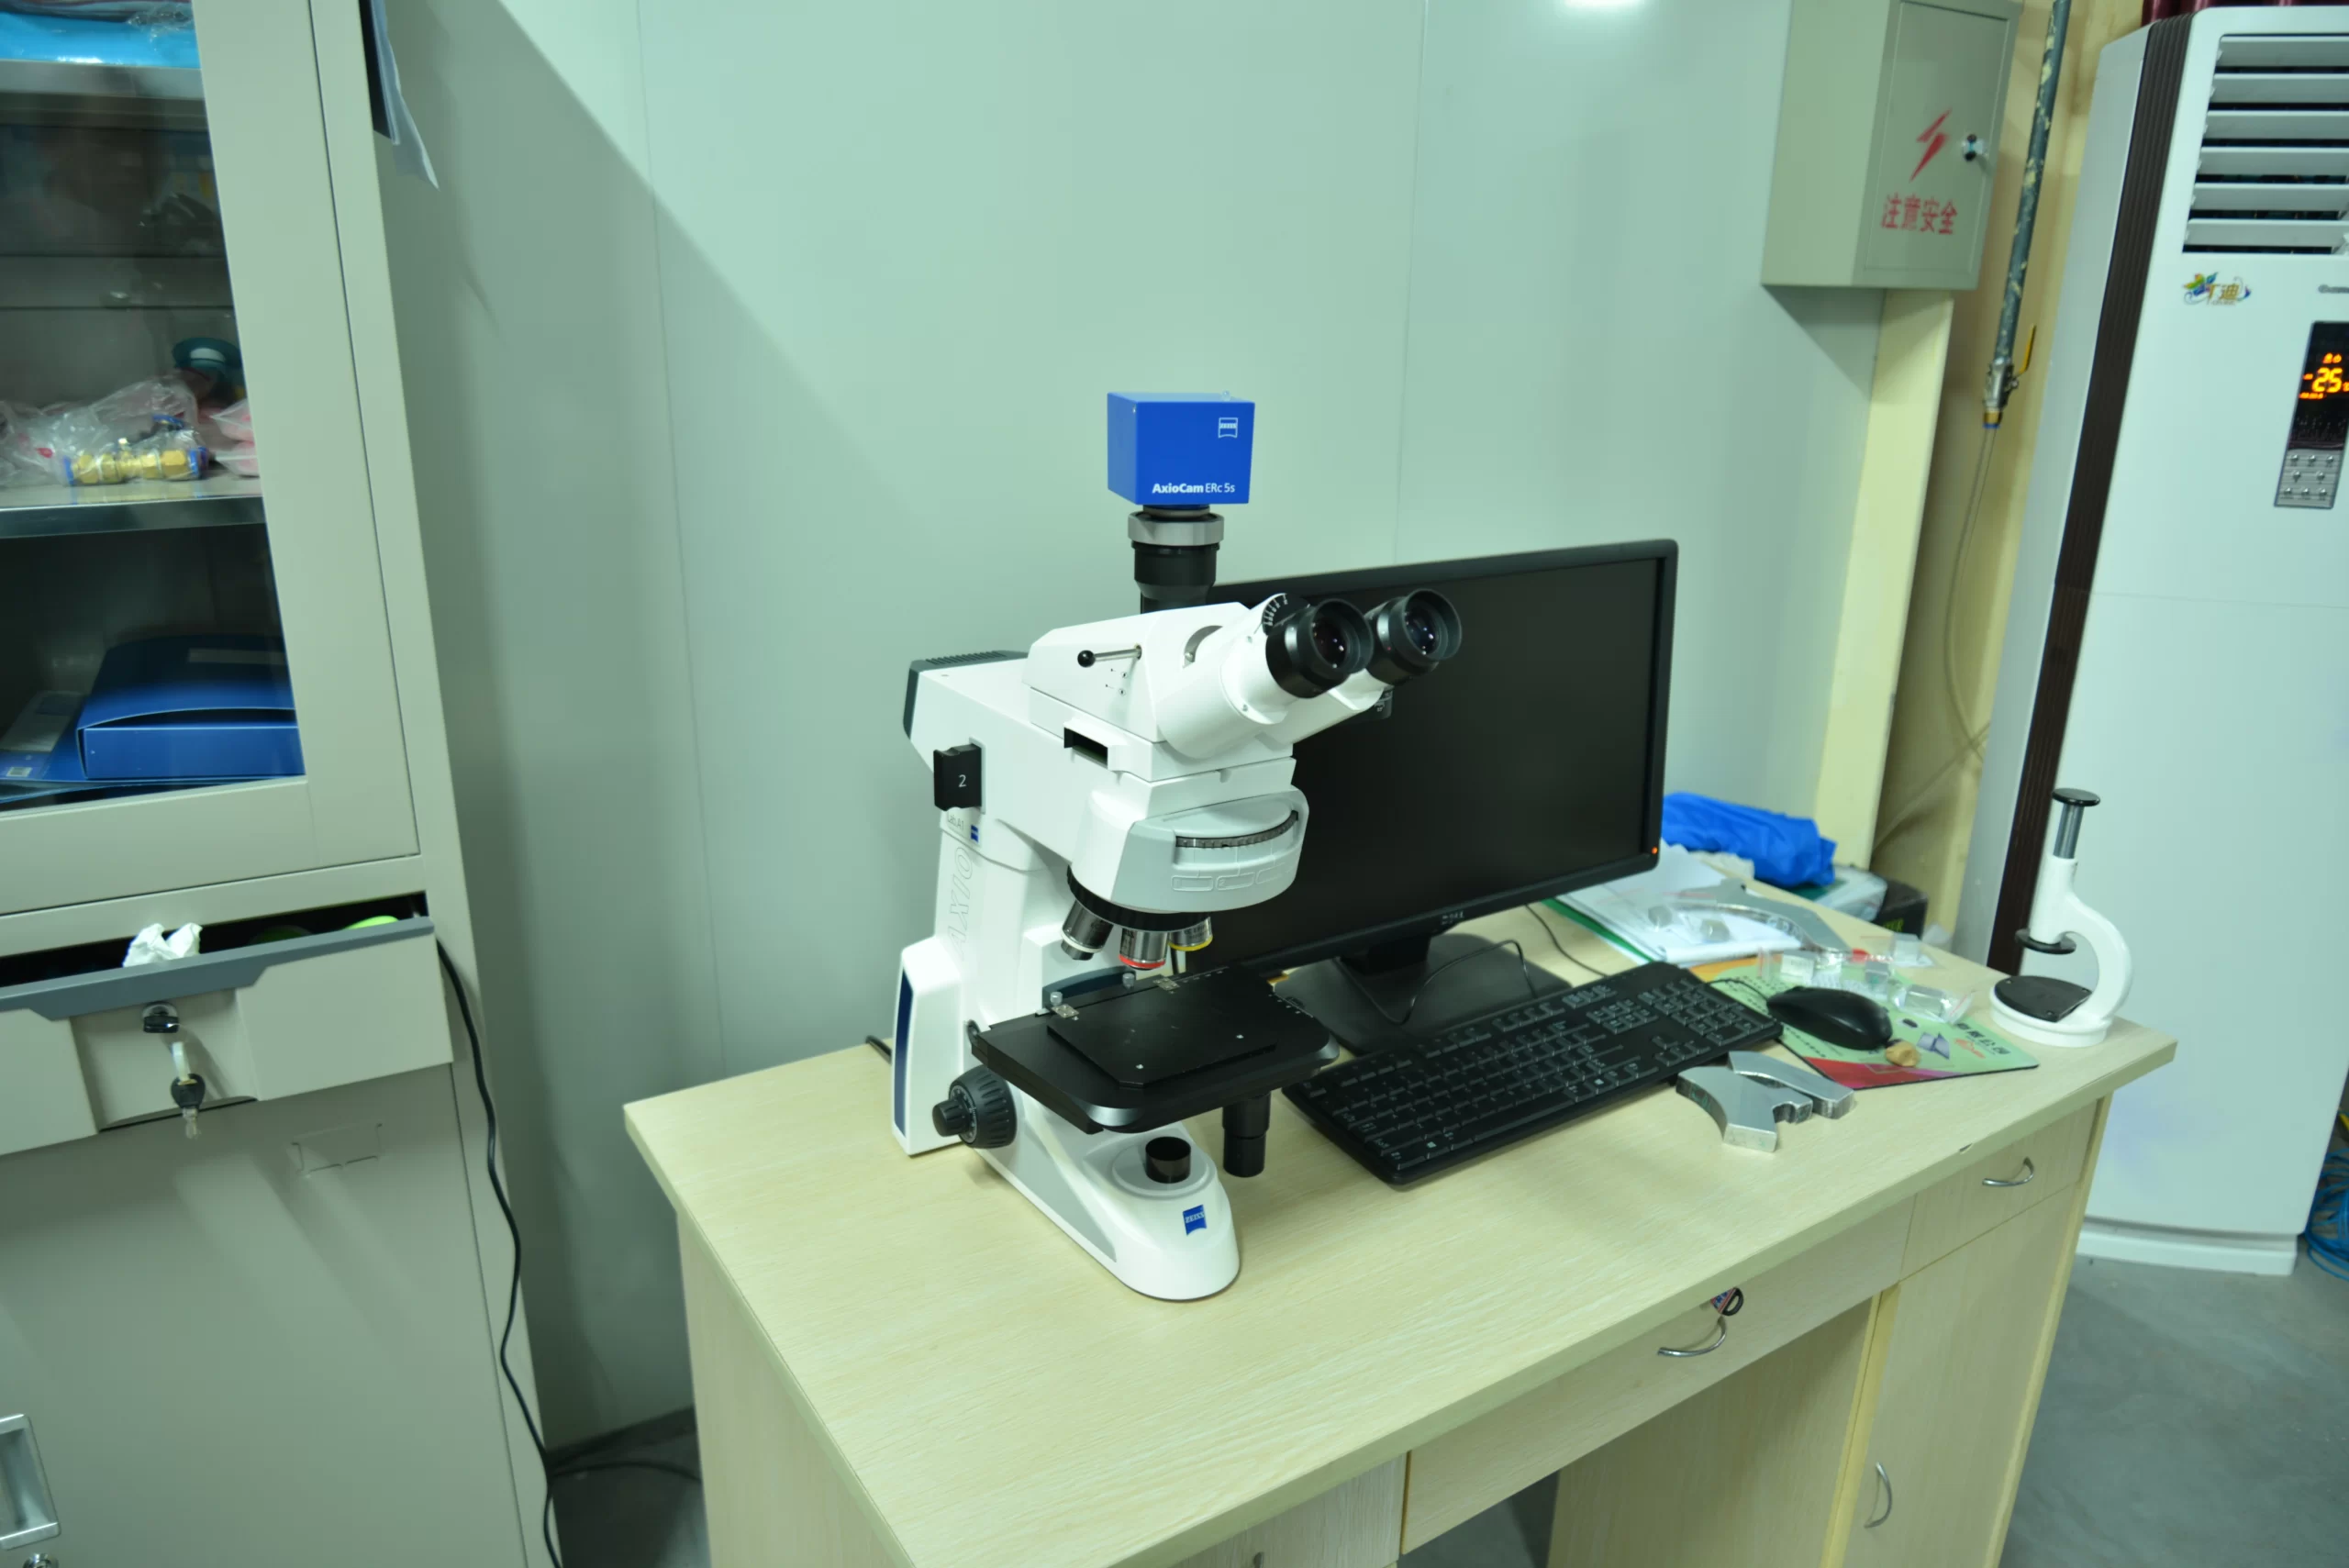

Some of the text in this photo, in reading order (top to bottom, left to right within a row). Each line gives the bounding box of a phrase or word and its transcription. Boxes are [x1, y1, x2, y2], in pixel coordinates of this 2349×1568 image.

[1880, 192, 1957, 235] 注意安全
[2312, 367, 2343, 393] 25
[1152, 482, 1236, 495] AxioCam ERc 5s
[958, 773, 967, 788] 2
[1185, 1211, 1206, 1224] ZEISS
